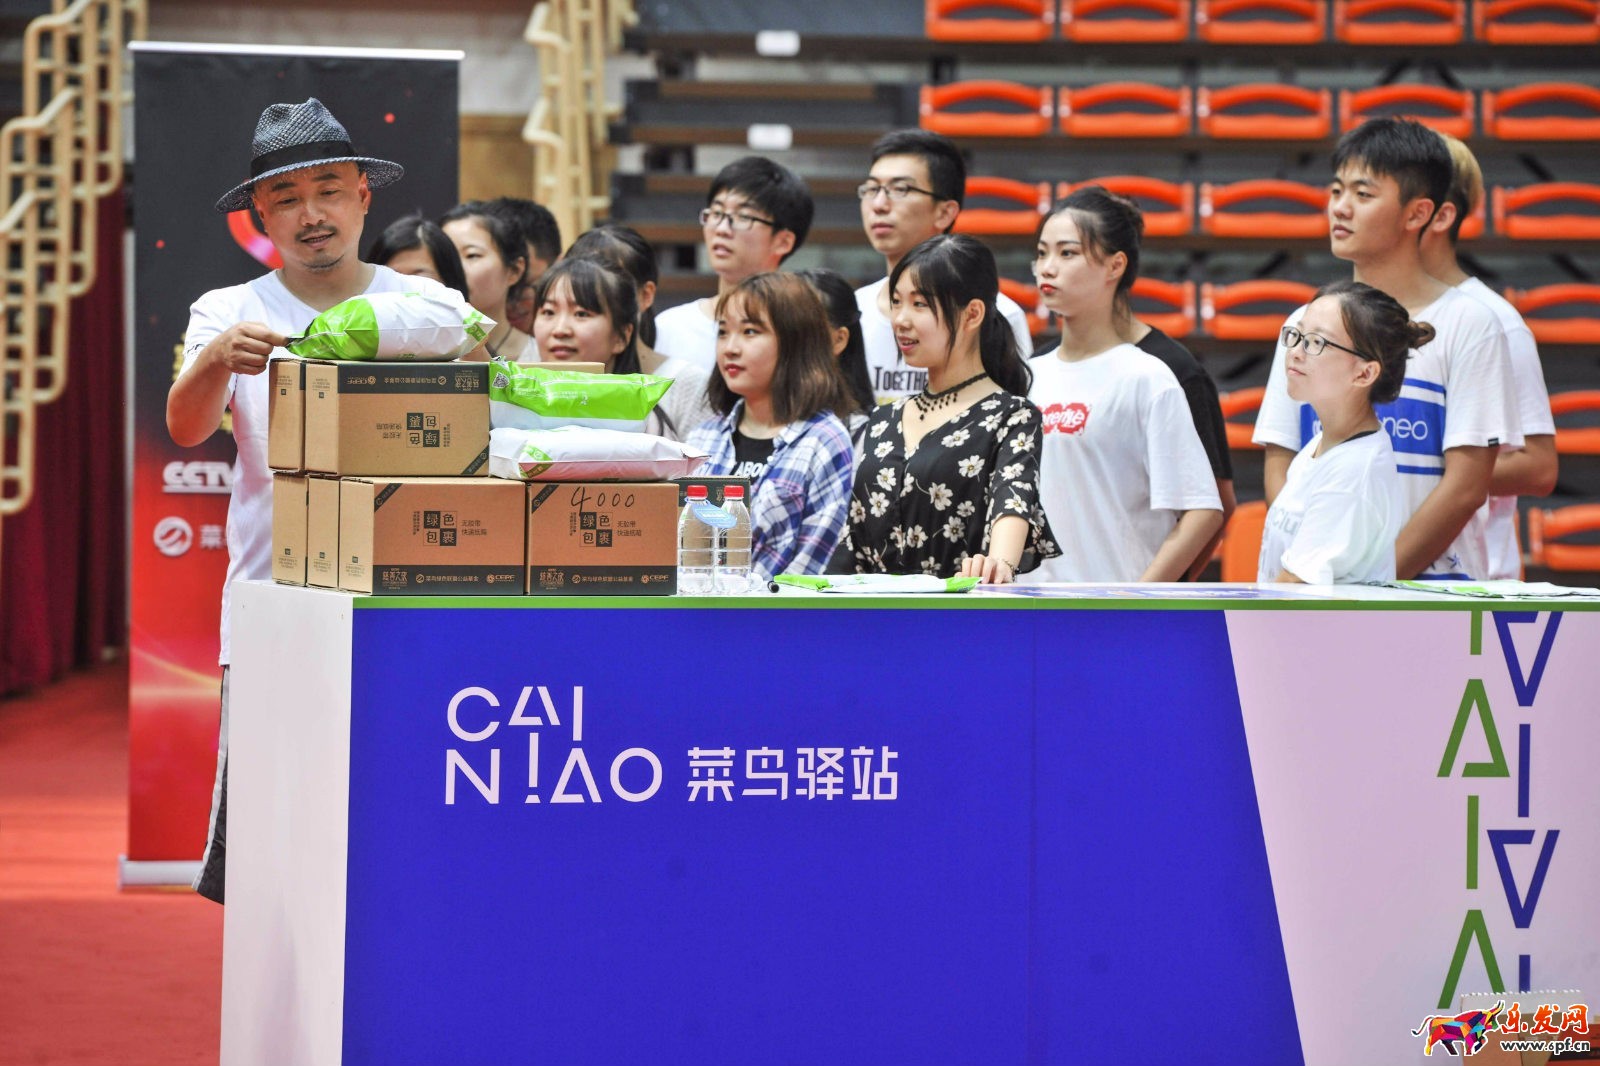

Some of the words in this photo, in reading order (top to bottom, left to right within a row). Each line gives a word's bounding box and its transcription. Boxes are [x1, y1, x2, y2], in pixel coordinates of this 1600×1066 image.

[408, 414, 438, 429] 包裹
[408, 431, 438, 446] 绿色
[570, 486, 635, 516] 4000
[425, 512, 455, 528] 绿色
[581, 513, 612, 529] 绿色
[425, 530, 455, 545] 包裹
[581, 530, 612, 546] 包裹
[446, 685, 584, 743] CAI
[687, 745, 899, 802] 菜鸟驿站
